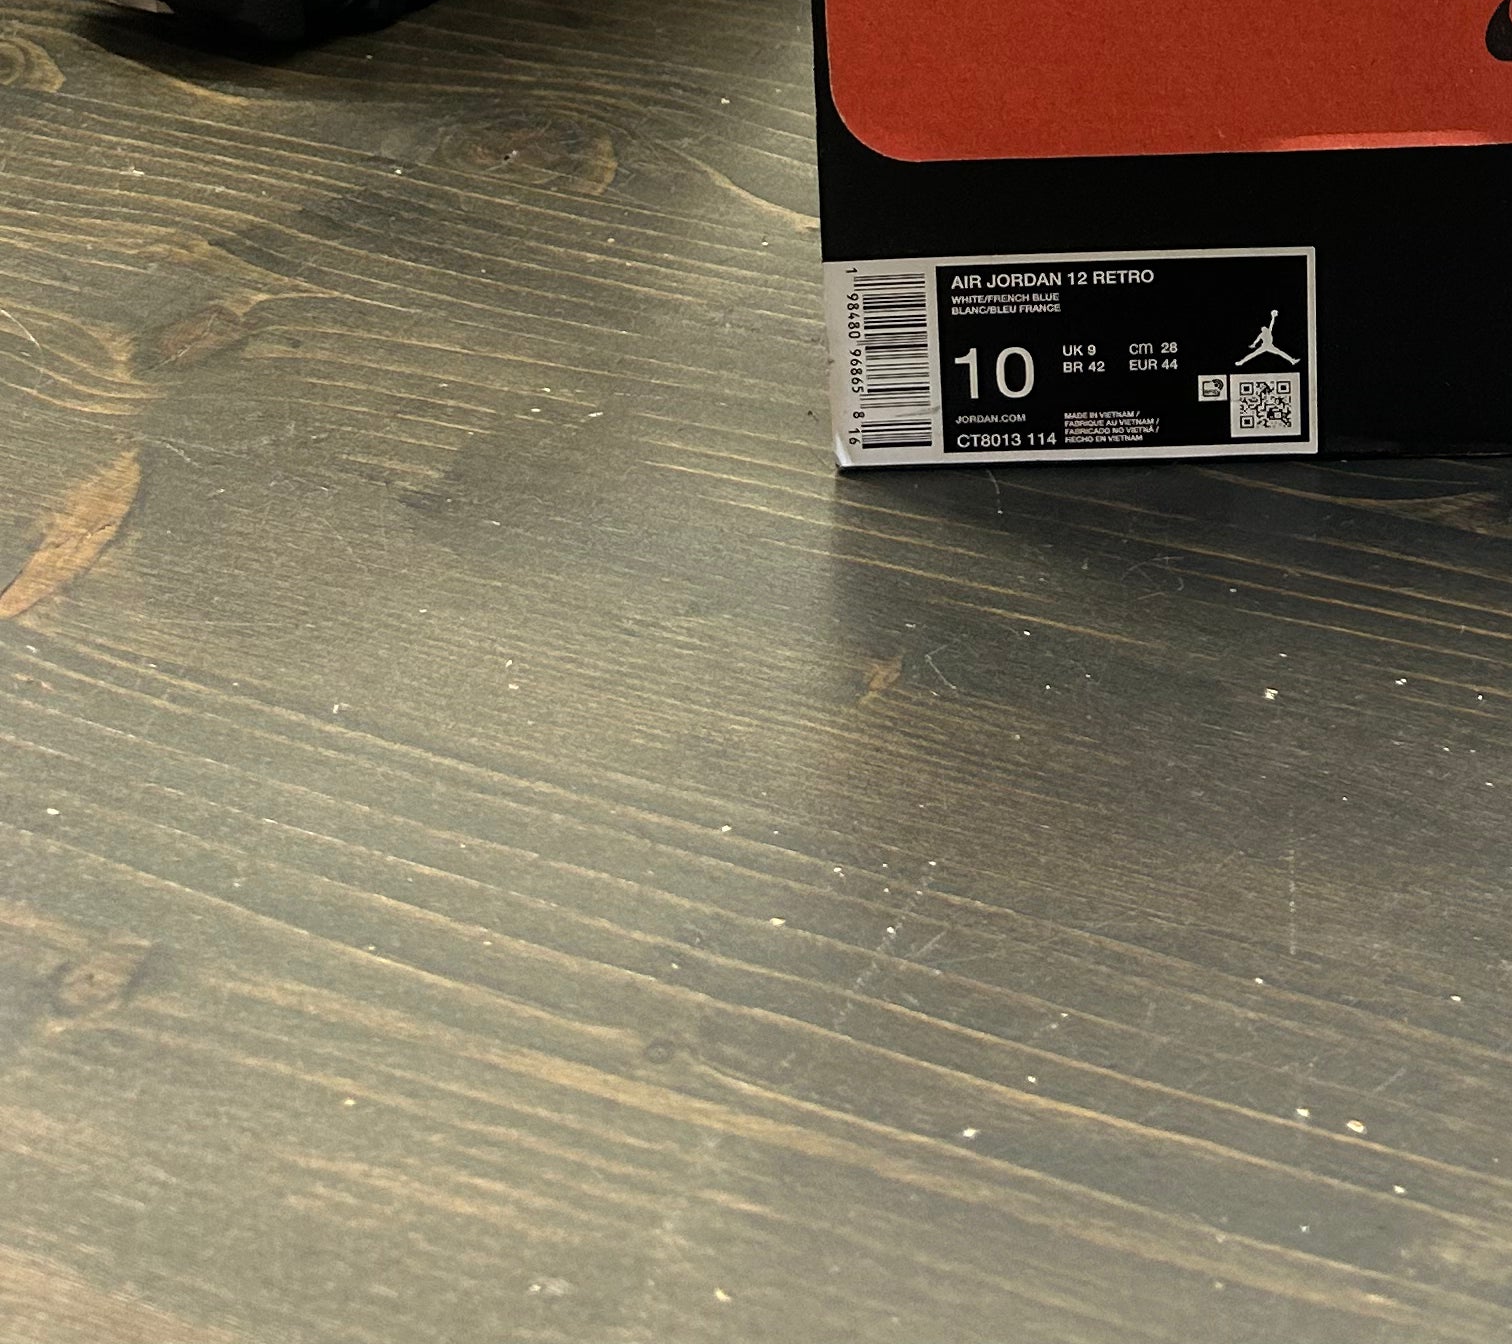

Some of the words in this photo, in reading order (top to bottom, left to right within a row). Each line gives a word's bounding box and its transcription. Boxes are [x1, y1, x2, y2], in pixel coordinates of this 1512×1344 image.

[951, 275, 982, 290] AIR
[986, 272, 1063, 288] JORDAN
[1067, 271, 1089, 286] 12
[1093, 269, 1155, 285] RETRO
[951, 294, 1030, 305] WHITE/FRENCH
[1032, 292, 1060, 302] BLUE
[847, 293, 861, 339] 98480
[951, 304, 1018, 316] BLANC/BLEU
[1018, 303, 1062, 314] FRANCE
[1062, 344, 1084, 356] UK
[1087, 344, 1097, 356] 9
[1160, 342, 1178, 354] 28
[1062, 361, 1084, 373] BR
[1088, 360, 1106, 372] 42
[1128, 358, 1158, 371] EUR
[1161, 358, 1178, 370] 44
[850, 349, 864, 394] 96865
[954, 346, 1035, 399] 10
[955, 413, 1027, 425] JORDAN.COM
[1064, 412, 1088, 420] MADE
[956, 433, 1022, 448] CT8013
[1026, 432, 1058, 447] 114
